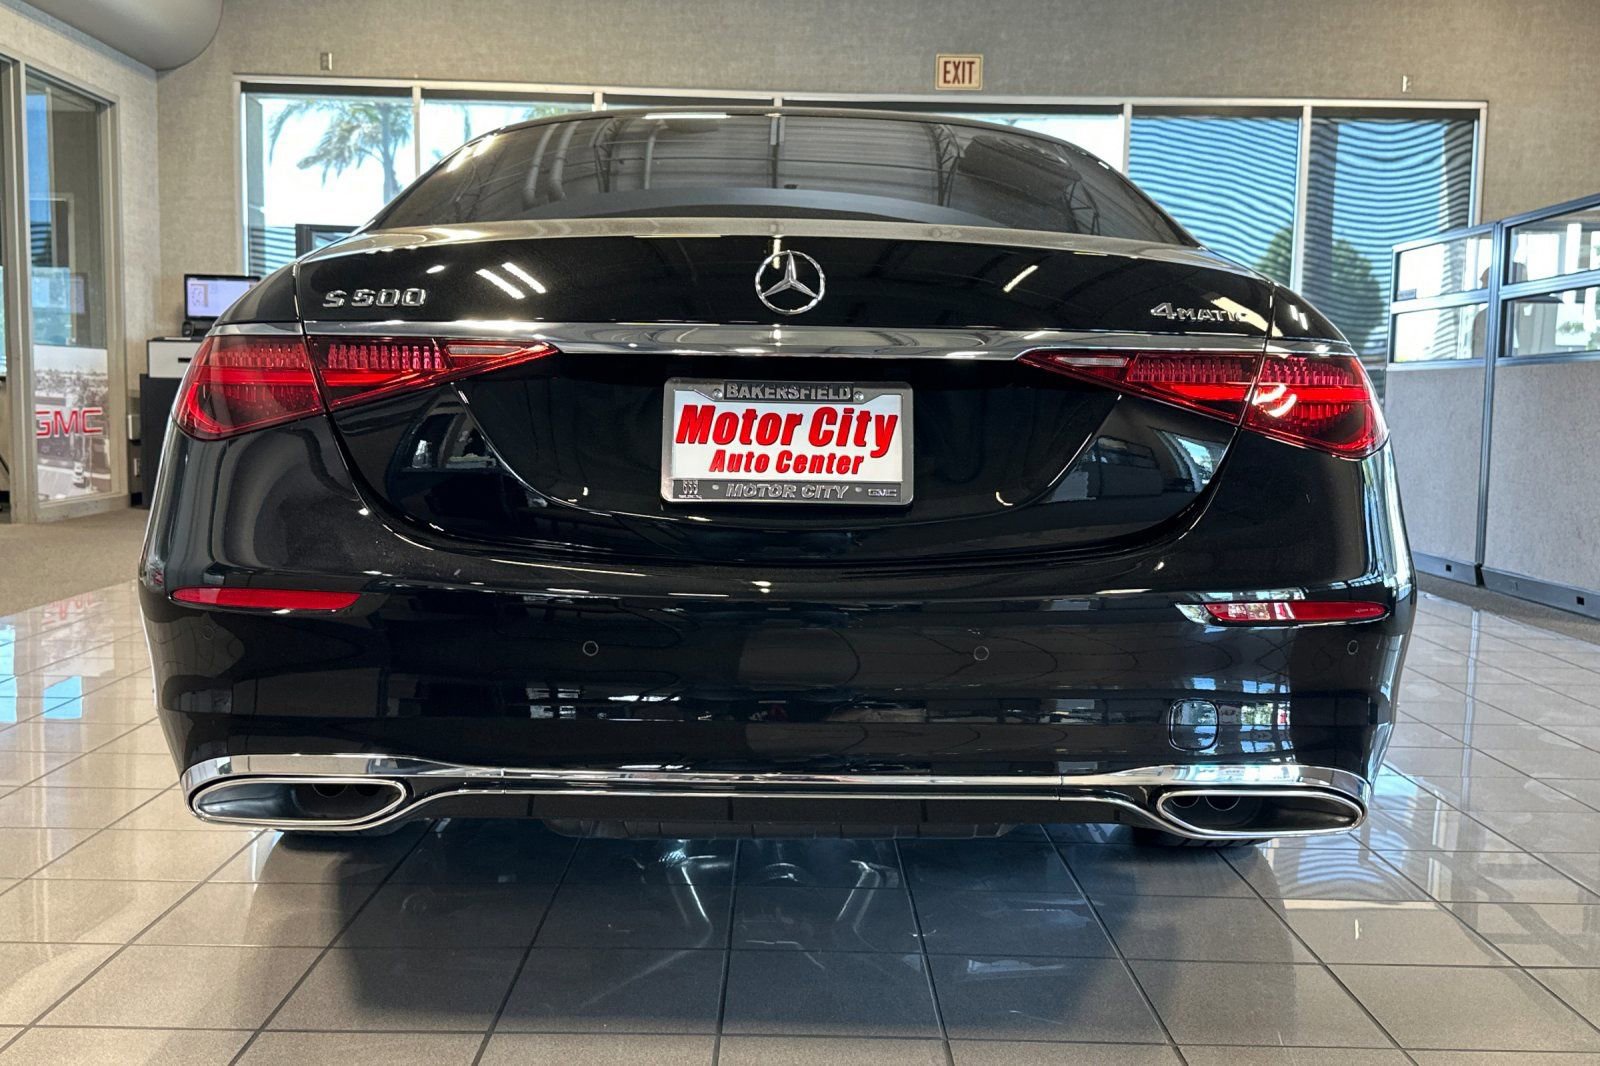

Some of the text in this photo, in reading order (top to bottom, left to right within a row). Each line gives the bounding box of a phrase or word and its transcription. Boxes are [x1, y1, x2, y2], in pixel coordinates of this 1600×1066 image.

[943, 60, 976, 85] EXIT
[322, 288, 427, 308] S 500
[726, 383, 851, 400] BAKERSFIELD
[35, 407, 103, 438] GMC
[675, 404, 898, 458] Motor City
[709, 449, 865, 475] Auto Center
[726, 483, 849, 500] MOTOR CITY
